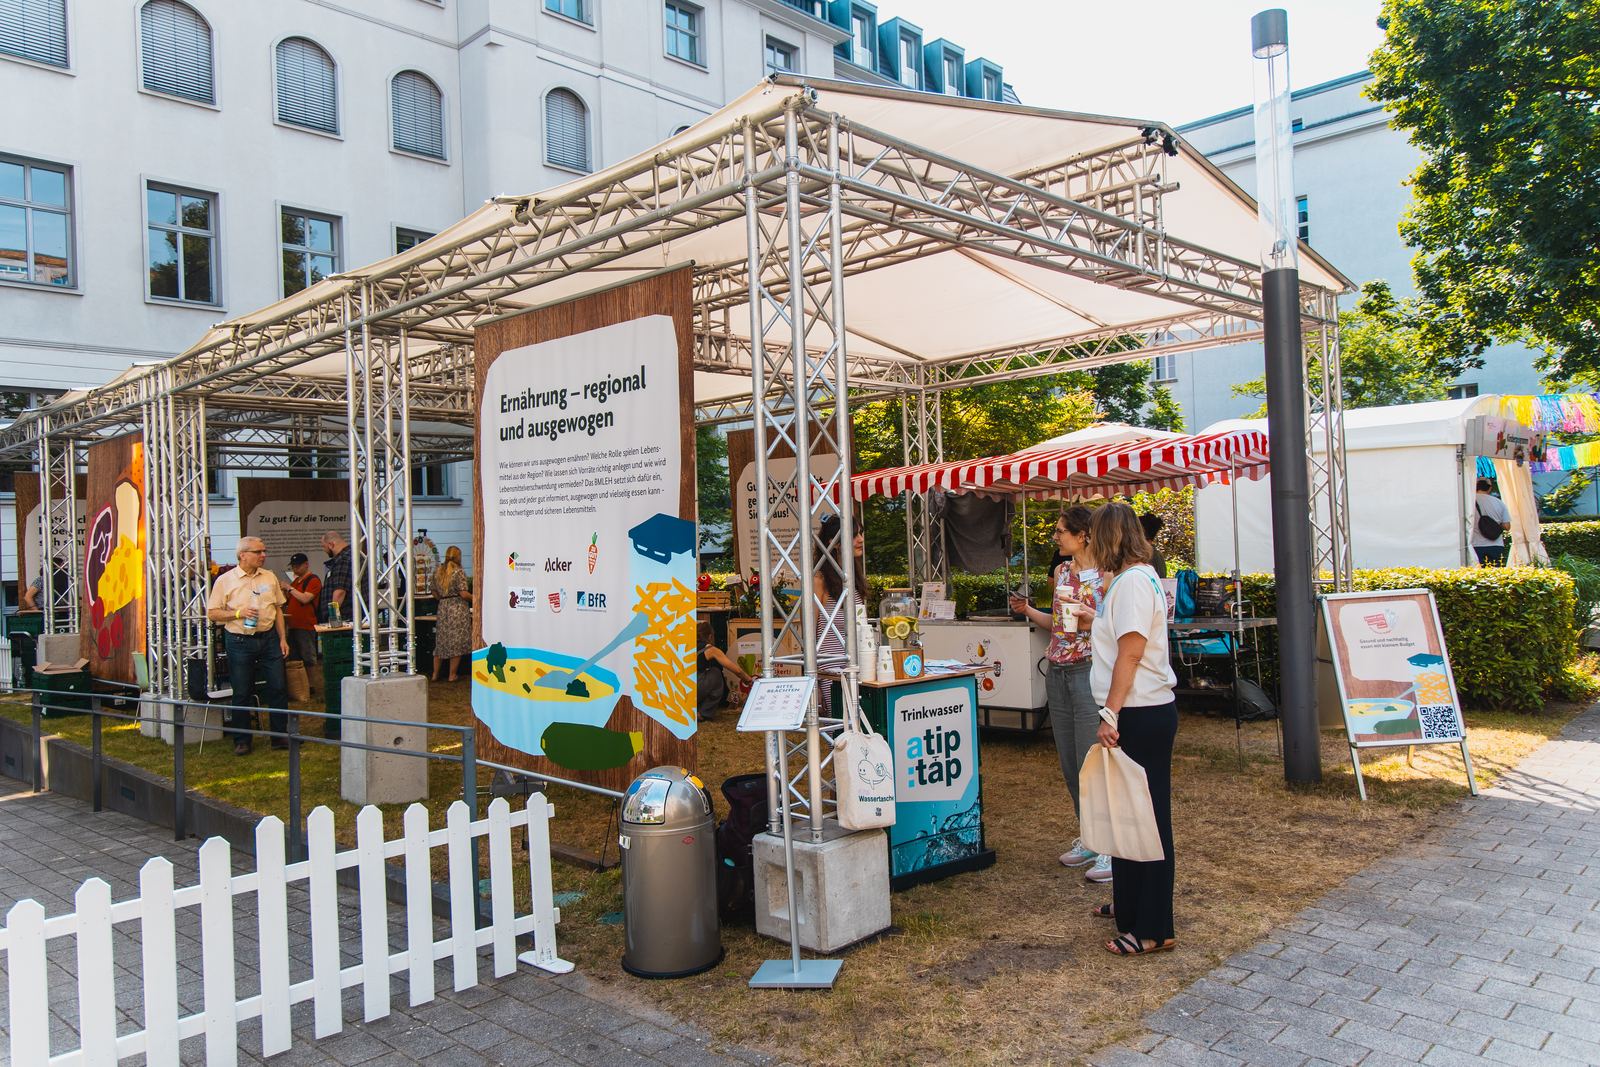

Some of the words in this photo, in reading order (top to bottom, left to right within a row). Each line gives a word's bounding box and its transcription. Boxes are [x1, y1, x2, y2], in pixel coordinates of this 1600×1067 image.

[500, 388, 568, 413] Ernährung
[584, 365, 646, 404] regional
[500, 417, 524, 442] und
[528, 410, 614, 441] ausgewogen
[540, 457, 566, 466] ausgewogen
[567, 452, 589, 463] ernähren?
[590, 451, 607, 460] Welche
[608, 449, 622, 458] Rolle
[623, 447, 639, 458] spielen
[640, 445, 661, 454] Lebens-
[527, 470, 544, 480] Region?
[569, 467, 577, 475] sich
[596, 464, 611, 473] richtig
[612, 463, 631, 472] anlegen
[632, 460, 642, 468] und
[644, 459, 653, 467] wie
[654, 458, 666, 466] wird
[499, 483, 557, 493] Lebensmittelverschwendung
[558, 479, 584, 488] vermieden?
[585, 478, 593, 487] Das
[594, 477, 612, 485] BMLEH
[614, 476, 626, 484] setzt
[627, 474, 636, 483] sich
[637, 473, 652, 482] dafür
[509, 497, 518, 505] jede
[526, 496, 537, 505] jeder
[570, 493, 598, 502] ausgewogen
[599, 491, 608, 499] und
[610, 489, 631, 498] vielseitig
[648, 487, 660, 495] kann
[272, 515, 287, 525] gut
[289, 514, 302, 522] für
[506, 509, 534, 517] hochwertigen
[563, 505, 596, 514] Lebensmitteln.
[544, 557, 572, 572] Acker
[588, 593, 606, 608] BfR
[900, 703, 964, 722] Trinkwasser
